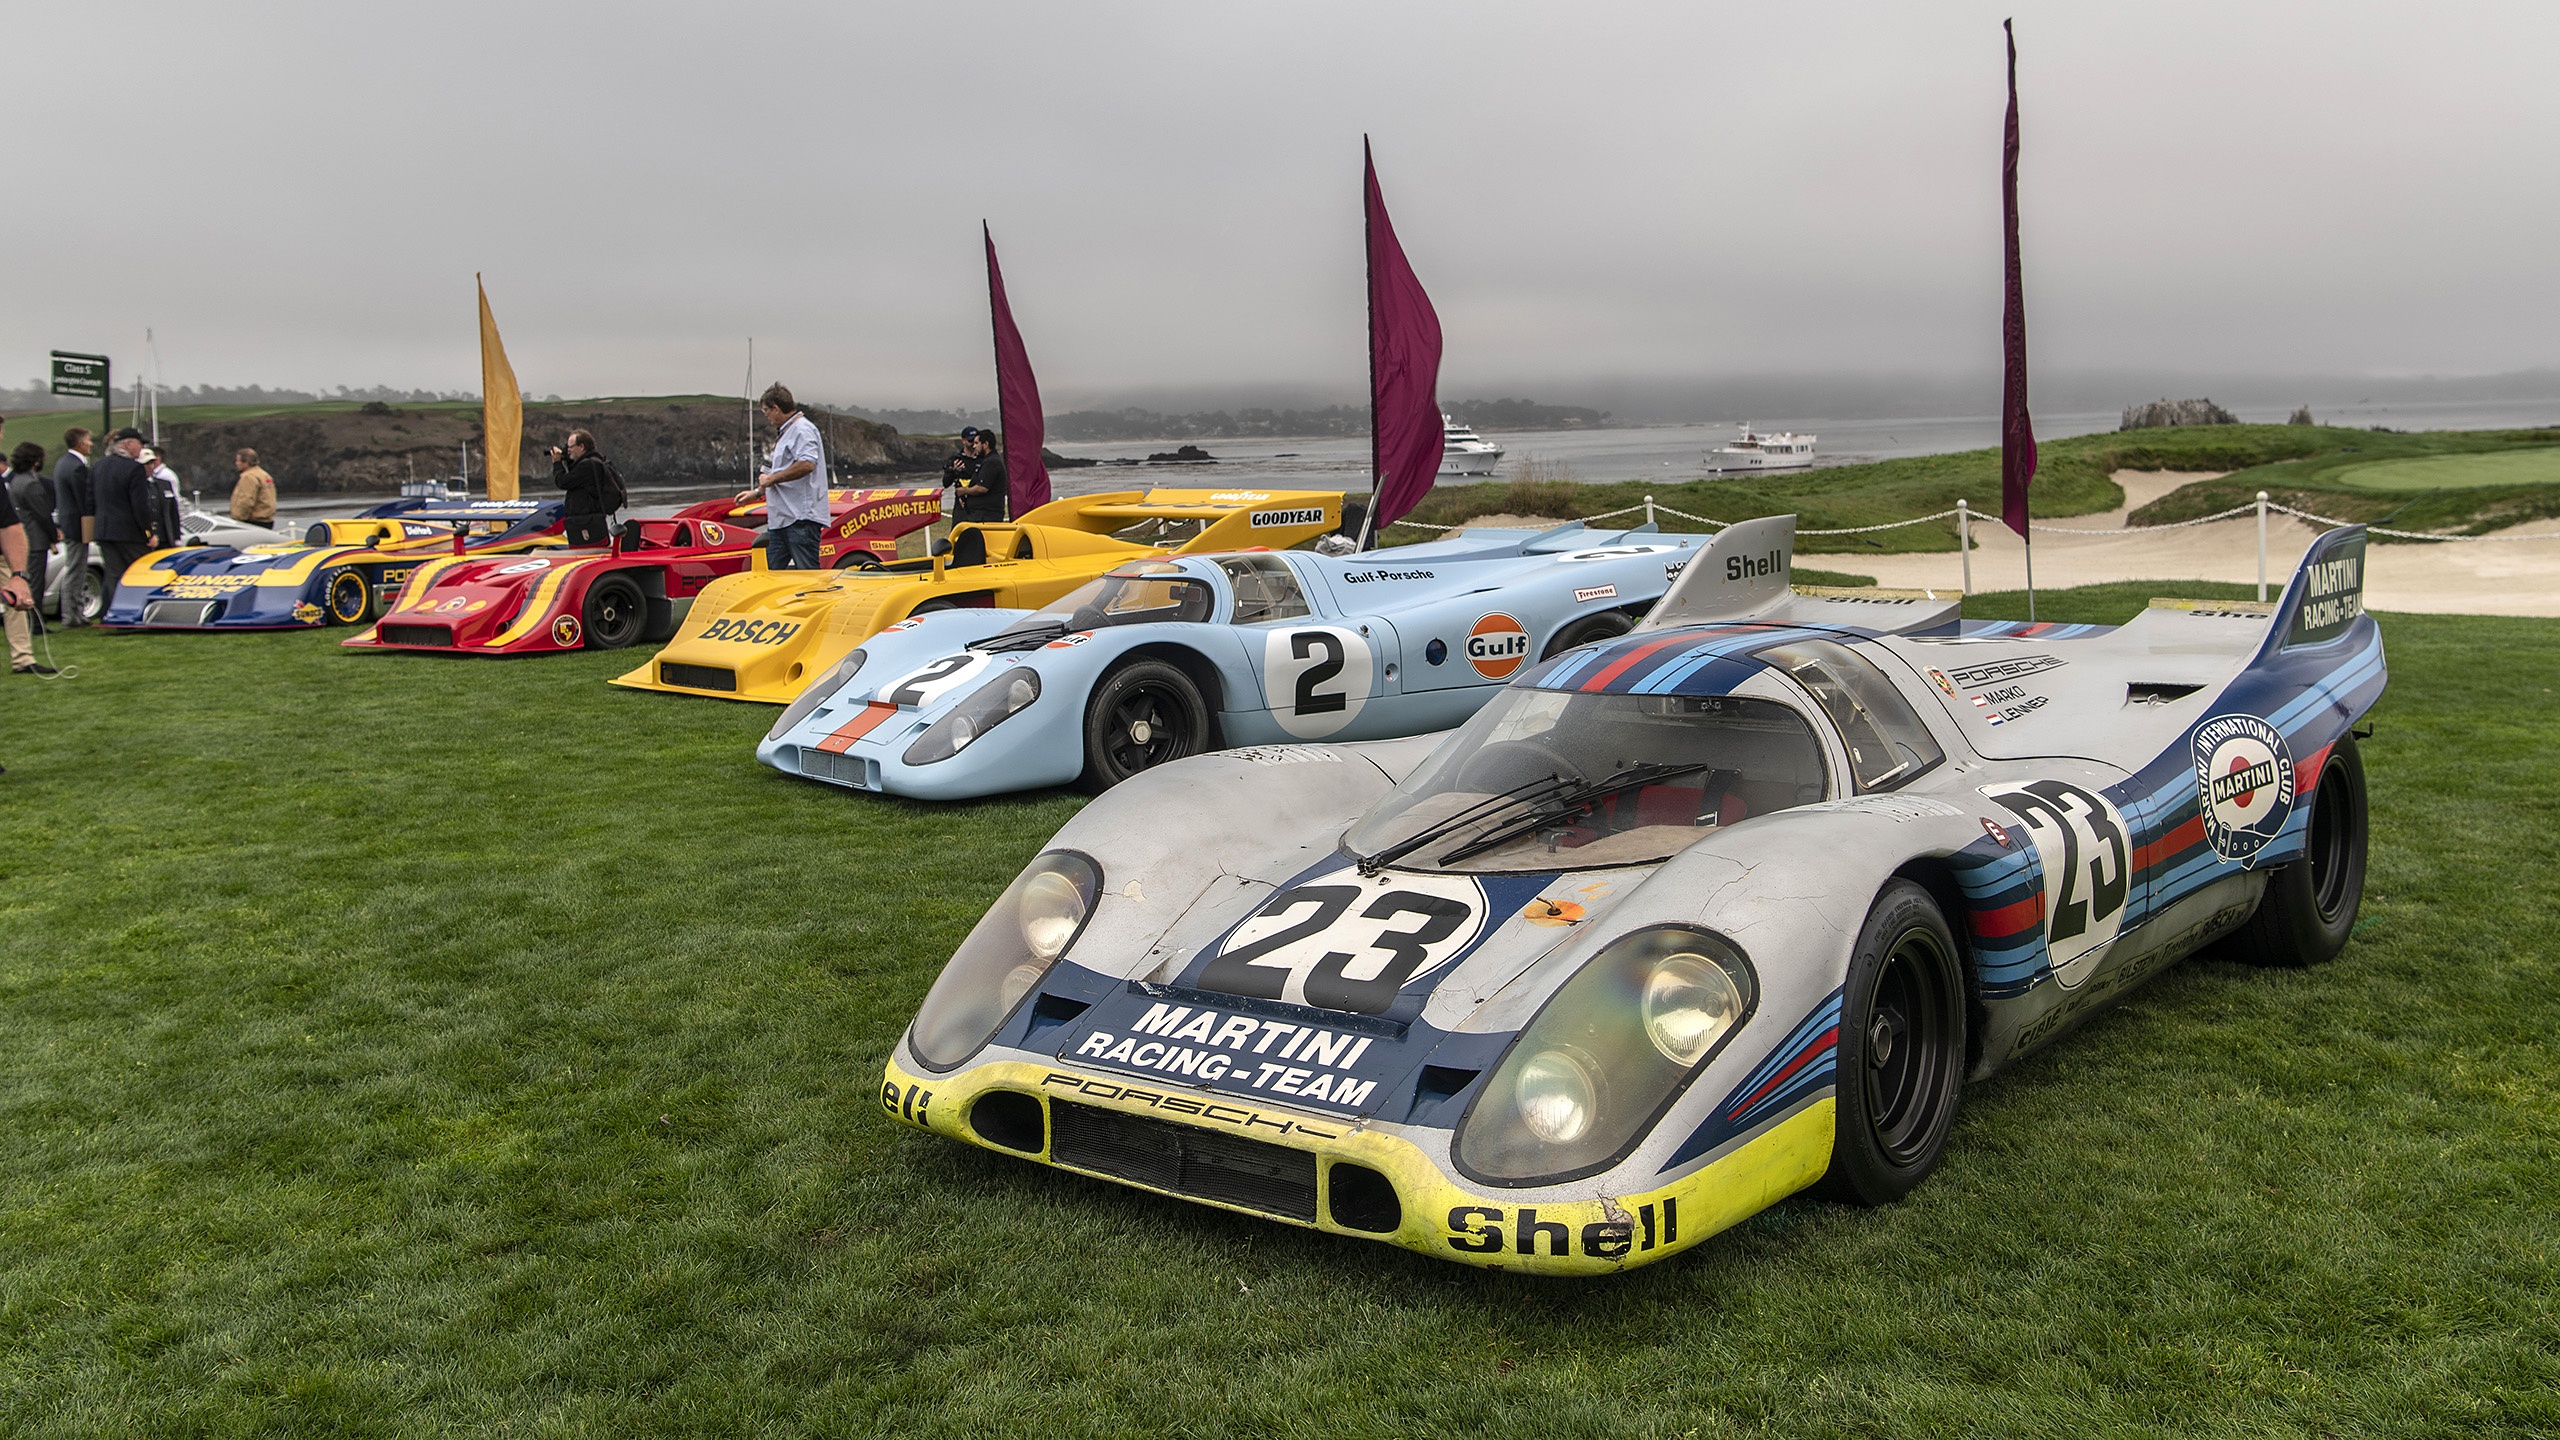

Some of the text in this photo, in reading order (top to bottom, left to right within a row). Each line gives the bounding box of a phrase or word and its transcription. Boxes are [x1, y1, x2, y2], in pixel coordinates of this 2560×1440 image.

[64, 363, 92, 375] Class S
[1210, 492, 1270, 501] GOODYEAR
[840, 501, 941, 538] GELO-RACING-TEAM
[1252, 509, 1322, 526] GOODYEAR
[169, 574, 260, 585] SUNOCO
[1343, 569, 1435, 584] Gulf-Porsche
[1726, 550, 1781, 580] Shell
[2307, 558, 2357, 597] MARTINI
[1577, 587, 1614, 599] Firestone
[1825, 597, 1916, 606] Shell
[295, 608, 323, 618] SUNOCO
[2304, 592, 2363, 630] RACING-TEAM
[697, 618, 802, 646] BOSCH
[1467, 635, 1527, 657] Gulf
[889, 654, 975, 707] 2
[1291, 631, 1347, 717] 2
[1951, 656, 2064, 685] PORSCHE
[1983, 685, 2027, 706] MARKO
[2196, 718, 2292, 837] MARTINI INTERNATIONAL CLUB
[2214, 763, 2274, 801] MARTINI
[1988, 779, 2127, 946] 23
[1196, 885, 1472, 1015] 23
[1130, 1002, 1374, 1071] MARTINI
[2017, 1007, 2062, 1050] CIBIE
[1075, 1030, 1379, 1108] RACING-TEAM
[1447, 1196, 1678, 1257] Shell
